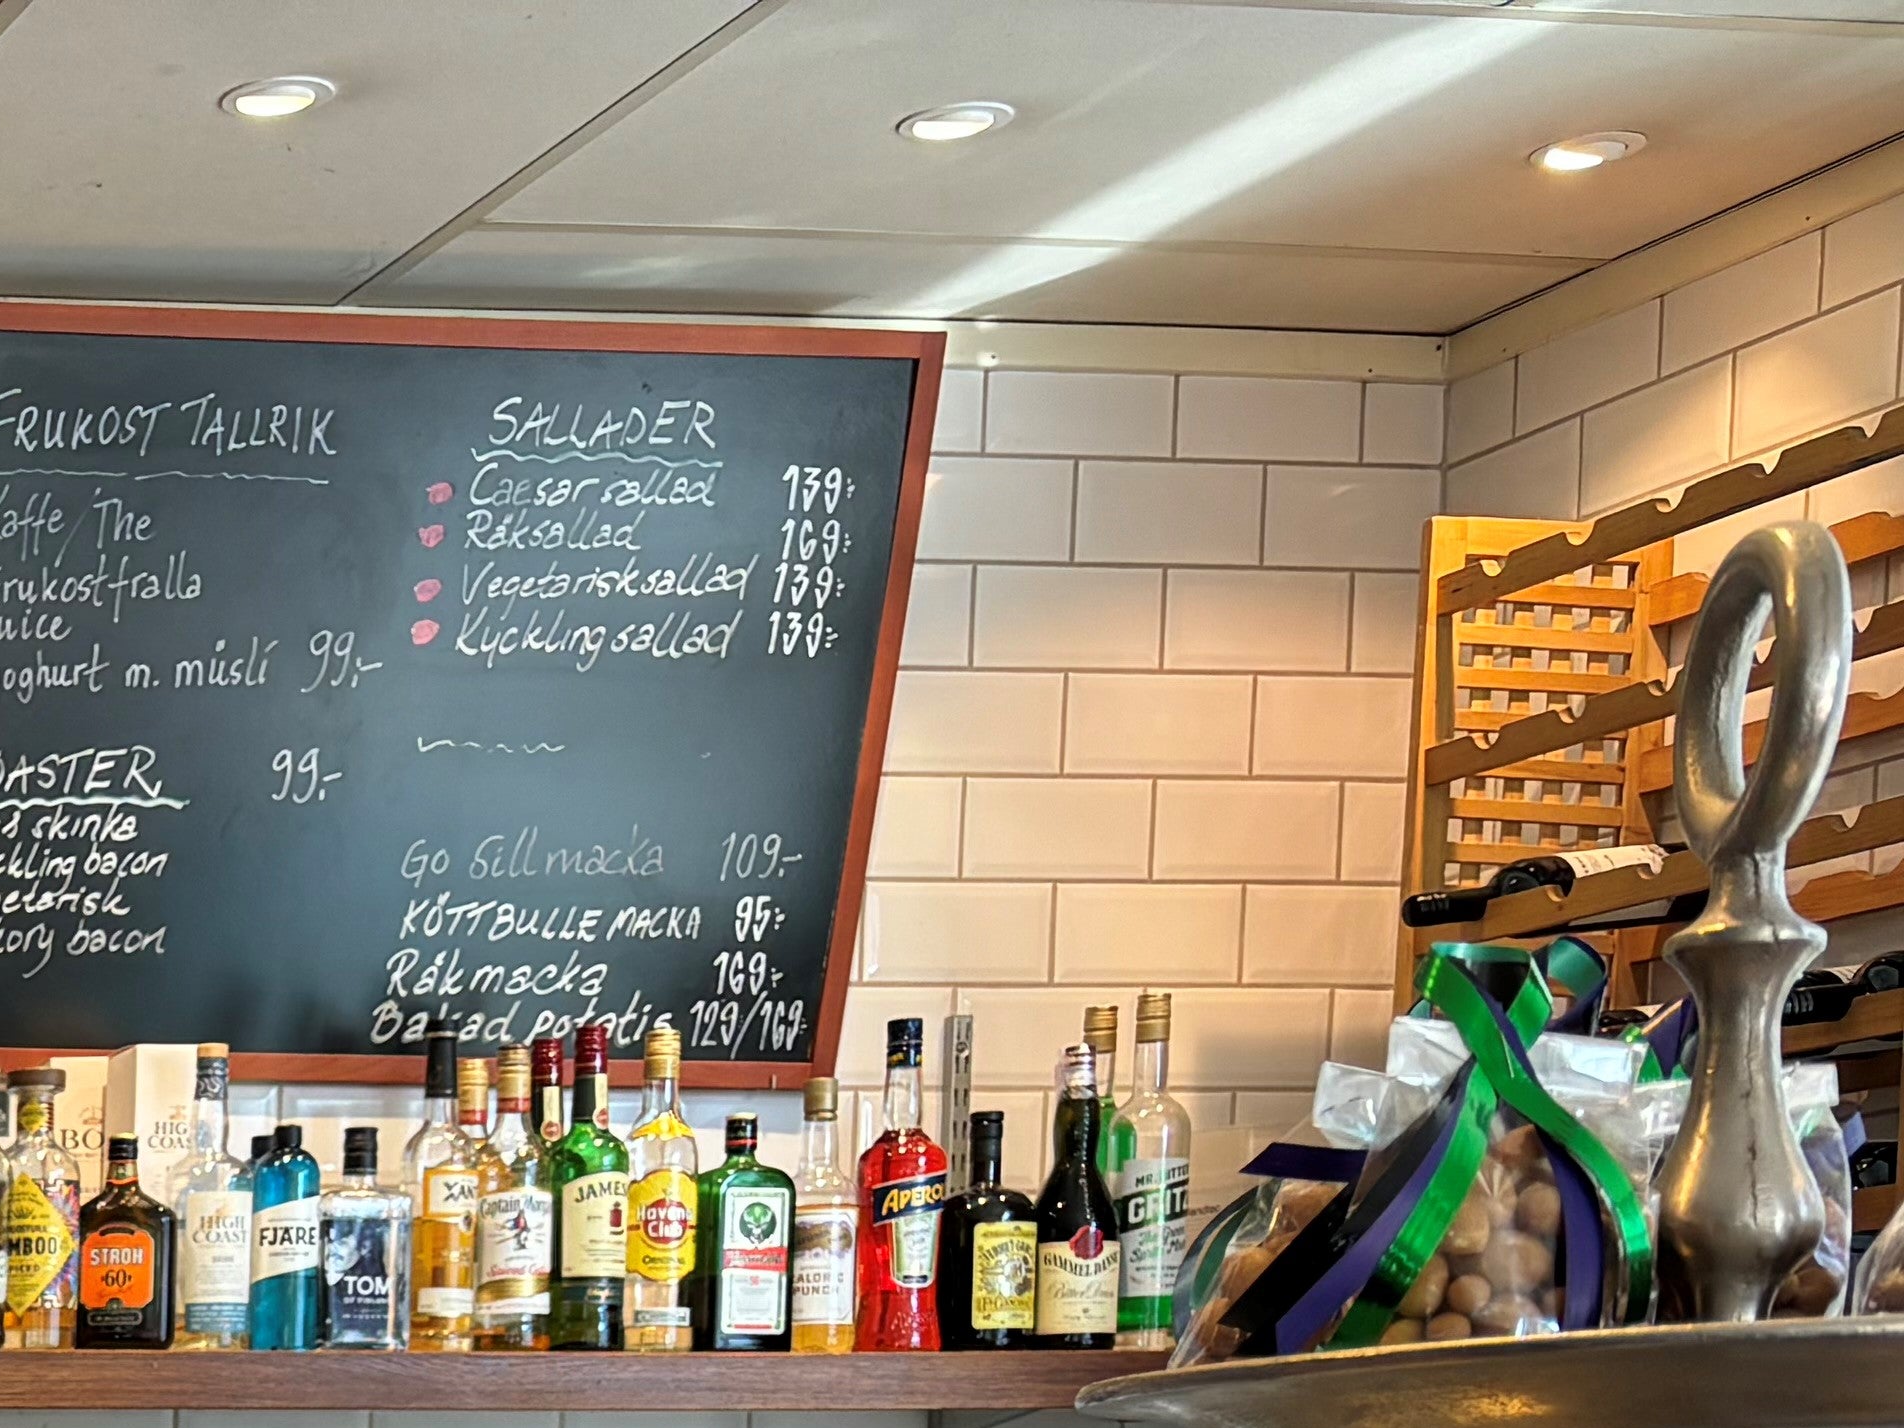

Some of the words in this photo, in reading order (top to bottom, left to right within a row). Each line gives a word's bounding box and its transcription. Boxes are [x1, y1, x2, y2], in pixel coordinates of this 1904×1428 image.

[181, 393, 336, 456] TALLRIK
[489, 396, 717, 450] SALLADER
[125, 664, 160, 689] m.
[32, 805, 139, 842] skinka
[83, 842, 170, 877] bacon
[66, 920, 168, 956] bacon
[154, 1122, 188, 1135] HIG
[647, 1221, 683, 1238] Club
[91, 1248, 144, 1266] STROH
[344, 1276, 392, 1296] TOM
